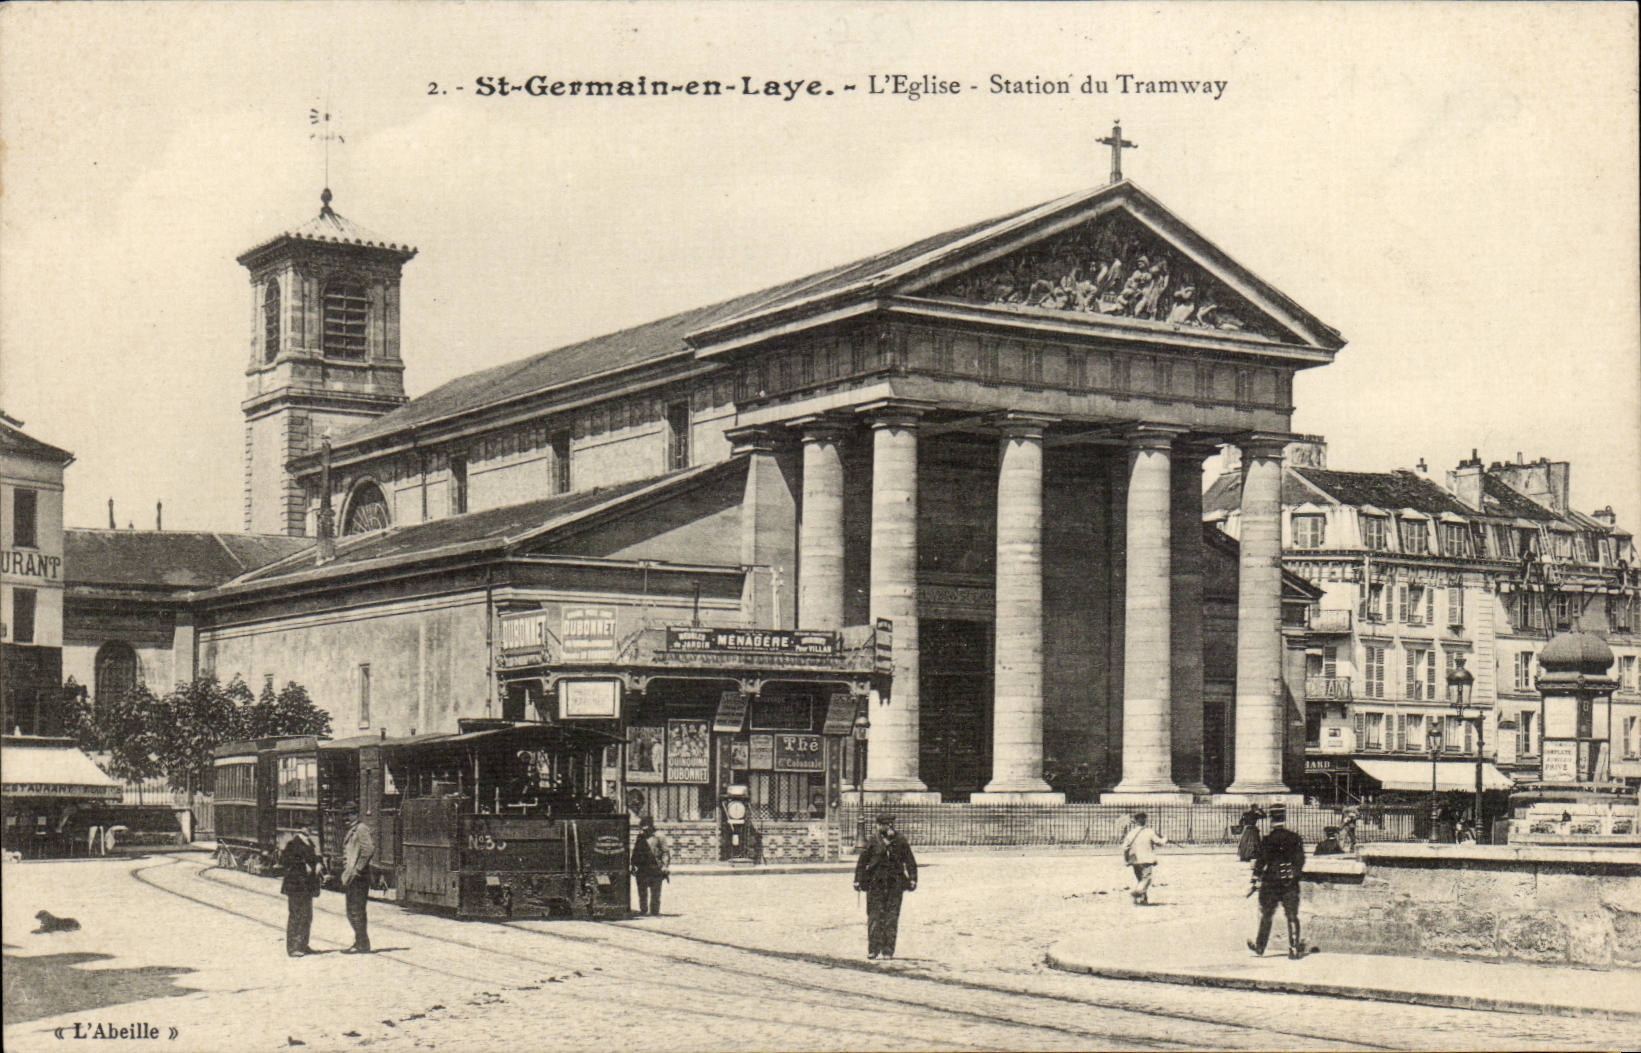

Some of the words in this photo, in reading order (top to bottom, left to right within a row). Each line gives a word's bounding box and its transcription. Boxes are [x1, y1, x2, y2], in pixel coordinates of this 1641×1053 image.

[563, 619, 616, 635] DUBONNET
[782, 736, 819, 752] Thé
[668, 767, 707, 781] DUBONNET
